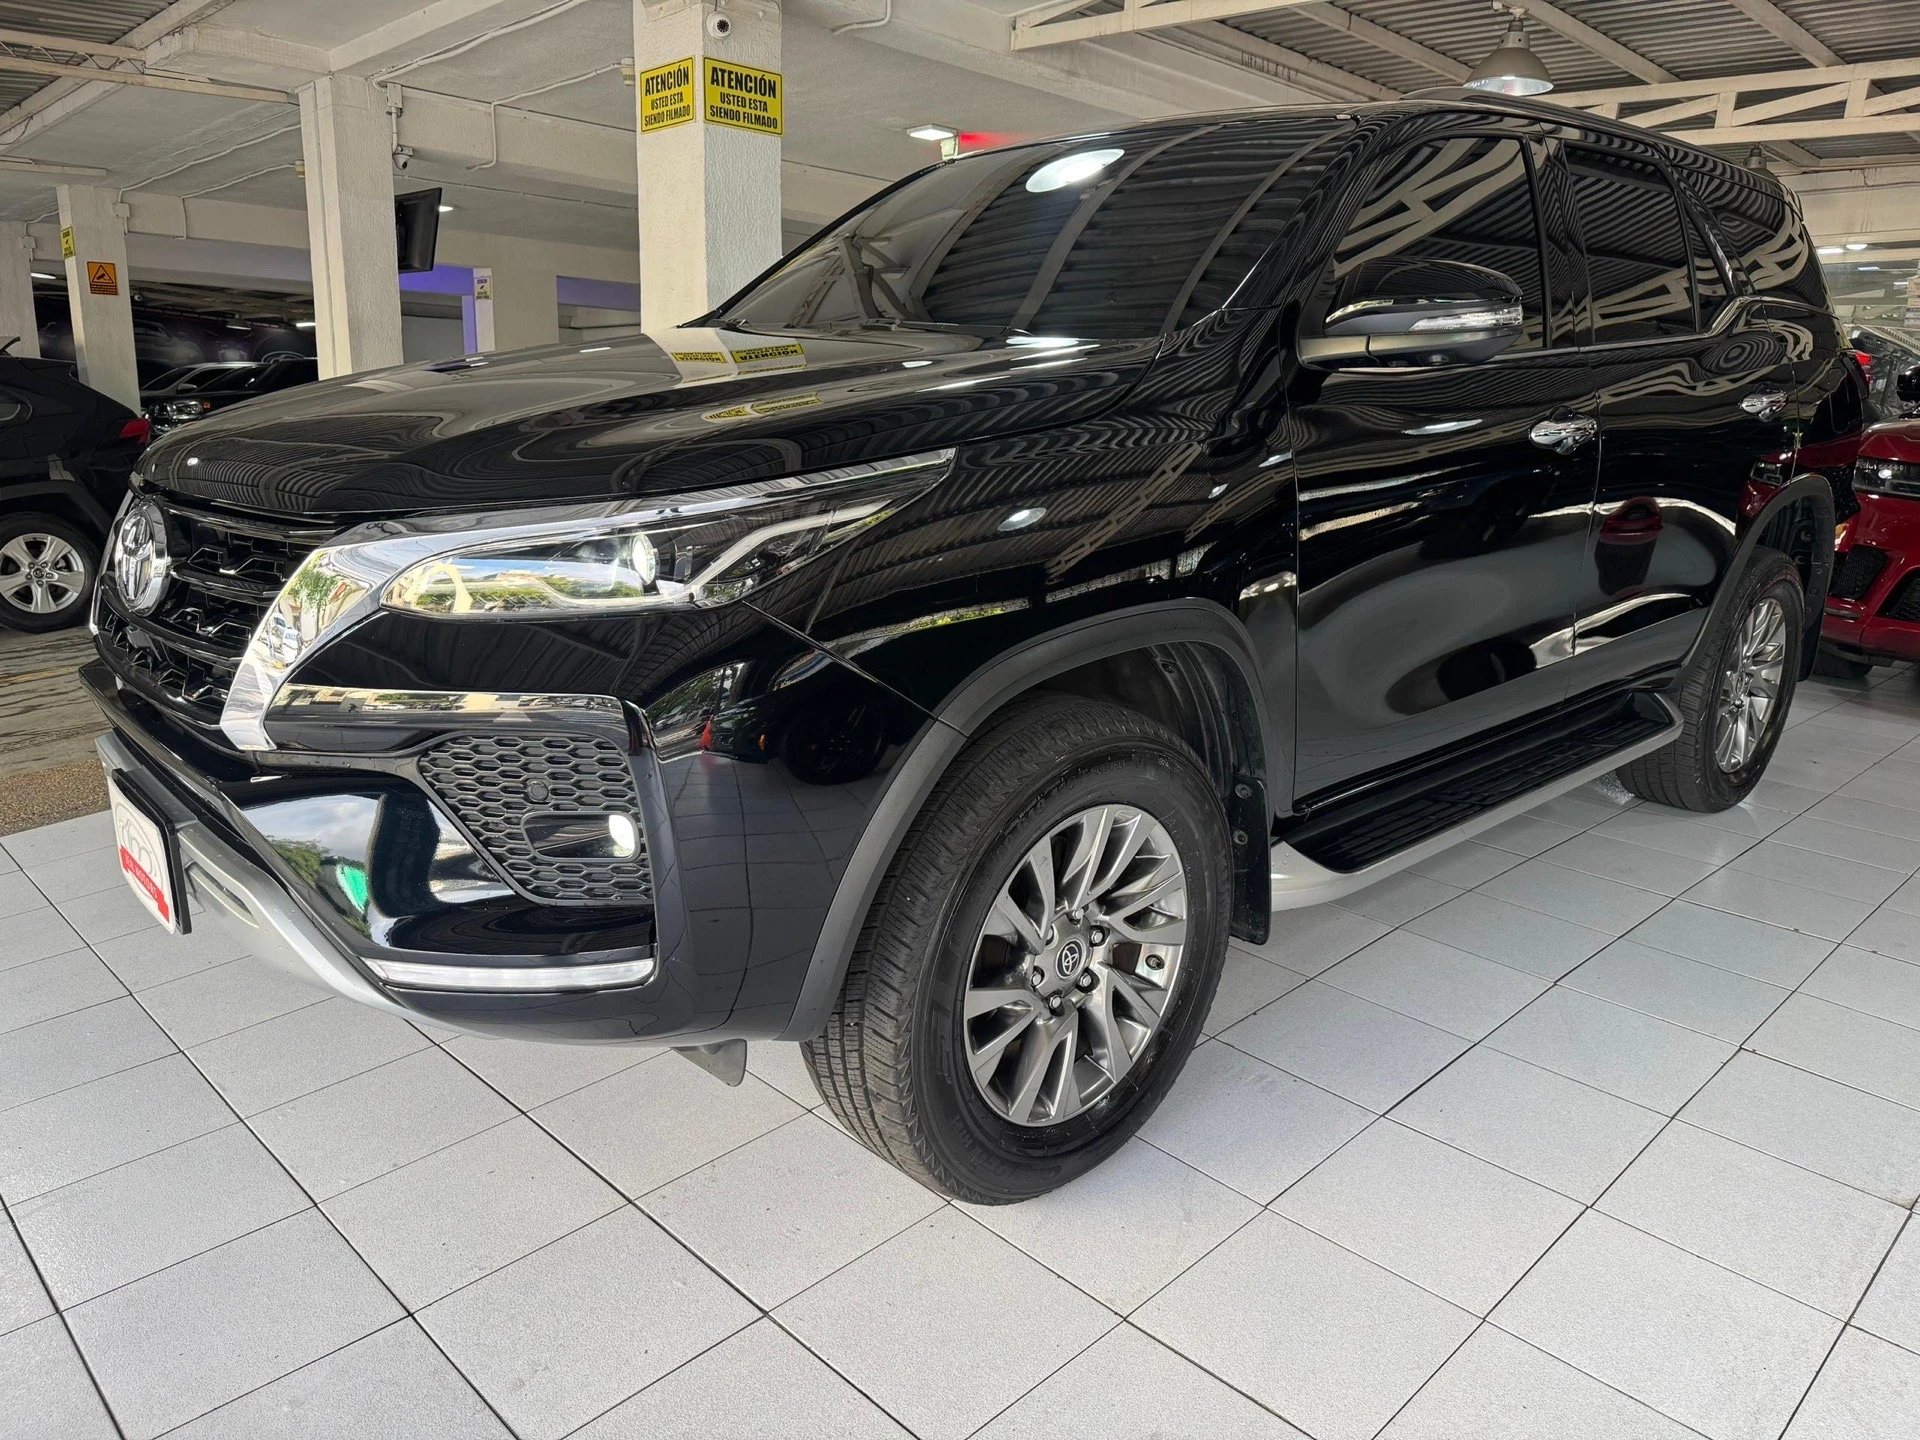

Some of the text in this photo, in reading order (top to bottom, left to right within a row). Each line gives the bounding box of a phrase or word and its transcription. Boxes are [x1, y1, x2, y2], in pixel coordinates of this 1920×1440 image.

[645, 64, 689, 97] ATENCIÓN
[711, 66, 776, 99] ATENCIÓN
[651, 91, 684, 111] USTED ESTA
[720, 91, 768, 113] USTED ESTA
[645, 104, 691, 127] SIENDO FILMADO
[710, 104, 778, 130] SIENDO FILMADO
